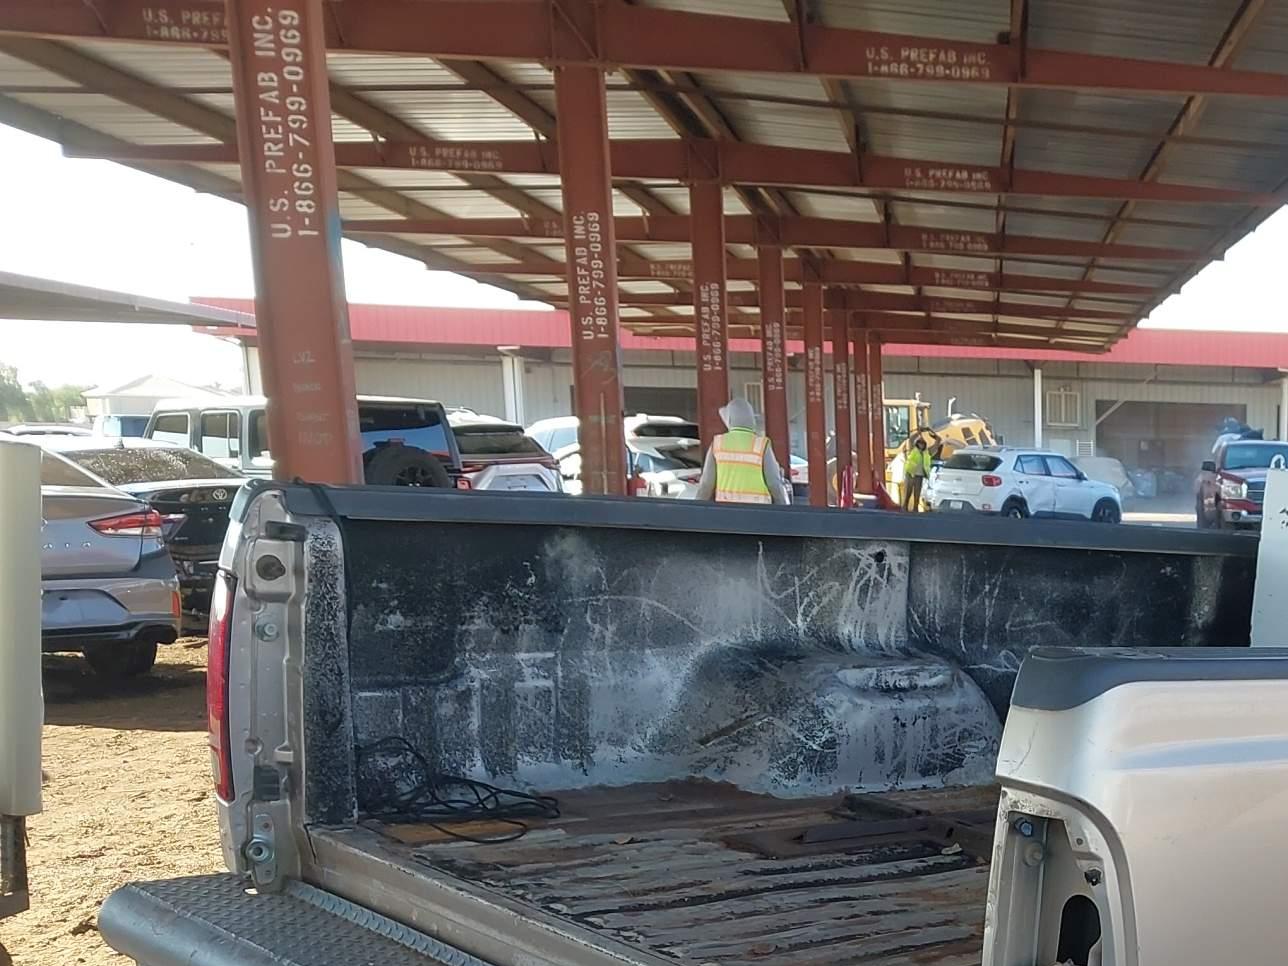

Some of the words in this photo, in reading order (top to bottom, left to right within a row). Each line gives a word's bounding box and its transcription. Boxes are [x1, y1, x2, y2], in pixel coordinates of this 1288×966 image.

[181, 10, 226, 27] PREF
[252, 7, 276, 57] INC.
[866, 47, 893, 60] U.S.
[901, 47, 957, 63] PREFAB
[257, 72, 287, 174] PREFAB
[279, 9, 319, 236] 1-866-799-0969
[269, 190, 292, 238] U.S.
[573, 211, 586, 239] INC.
[575, 247, 592, 304] PREFAB
[587, 212, 609, 337] 1-866-799-0969
[581, 312, 595, 340] U.S.
